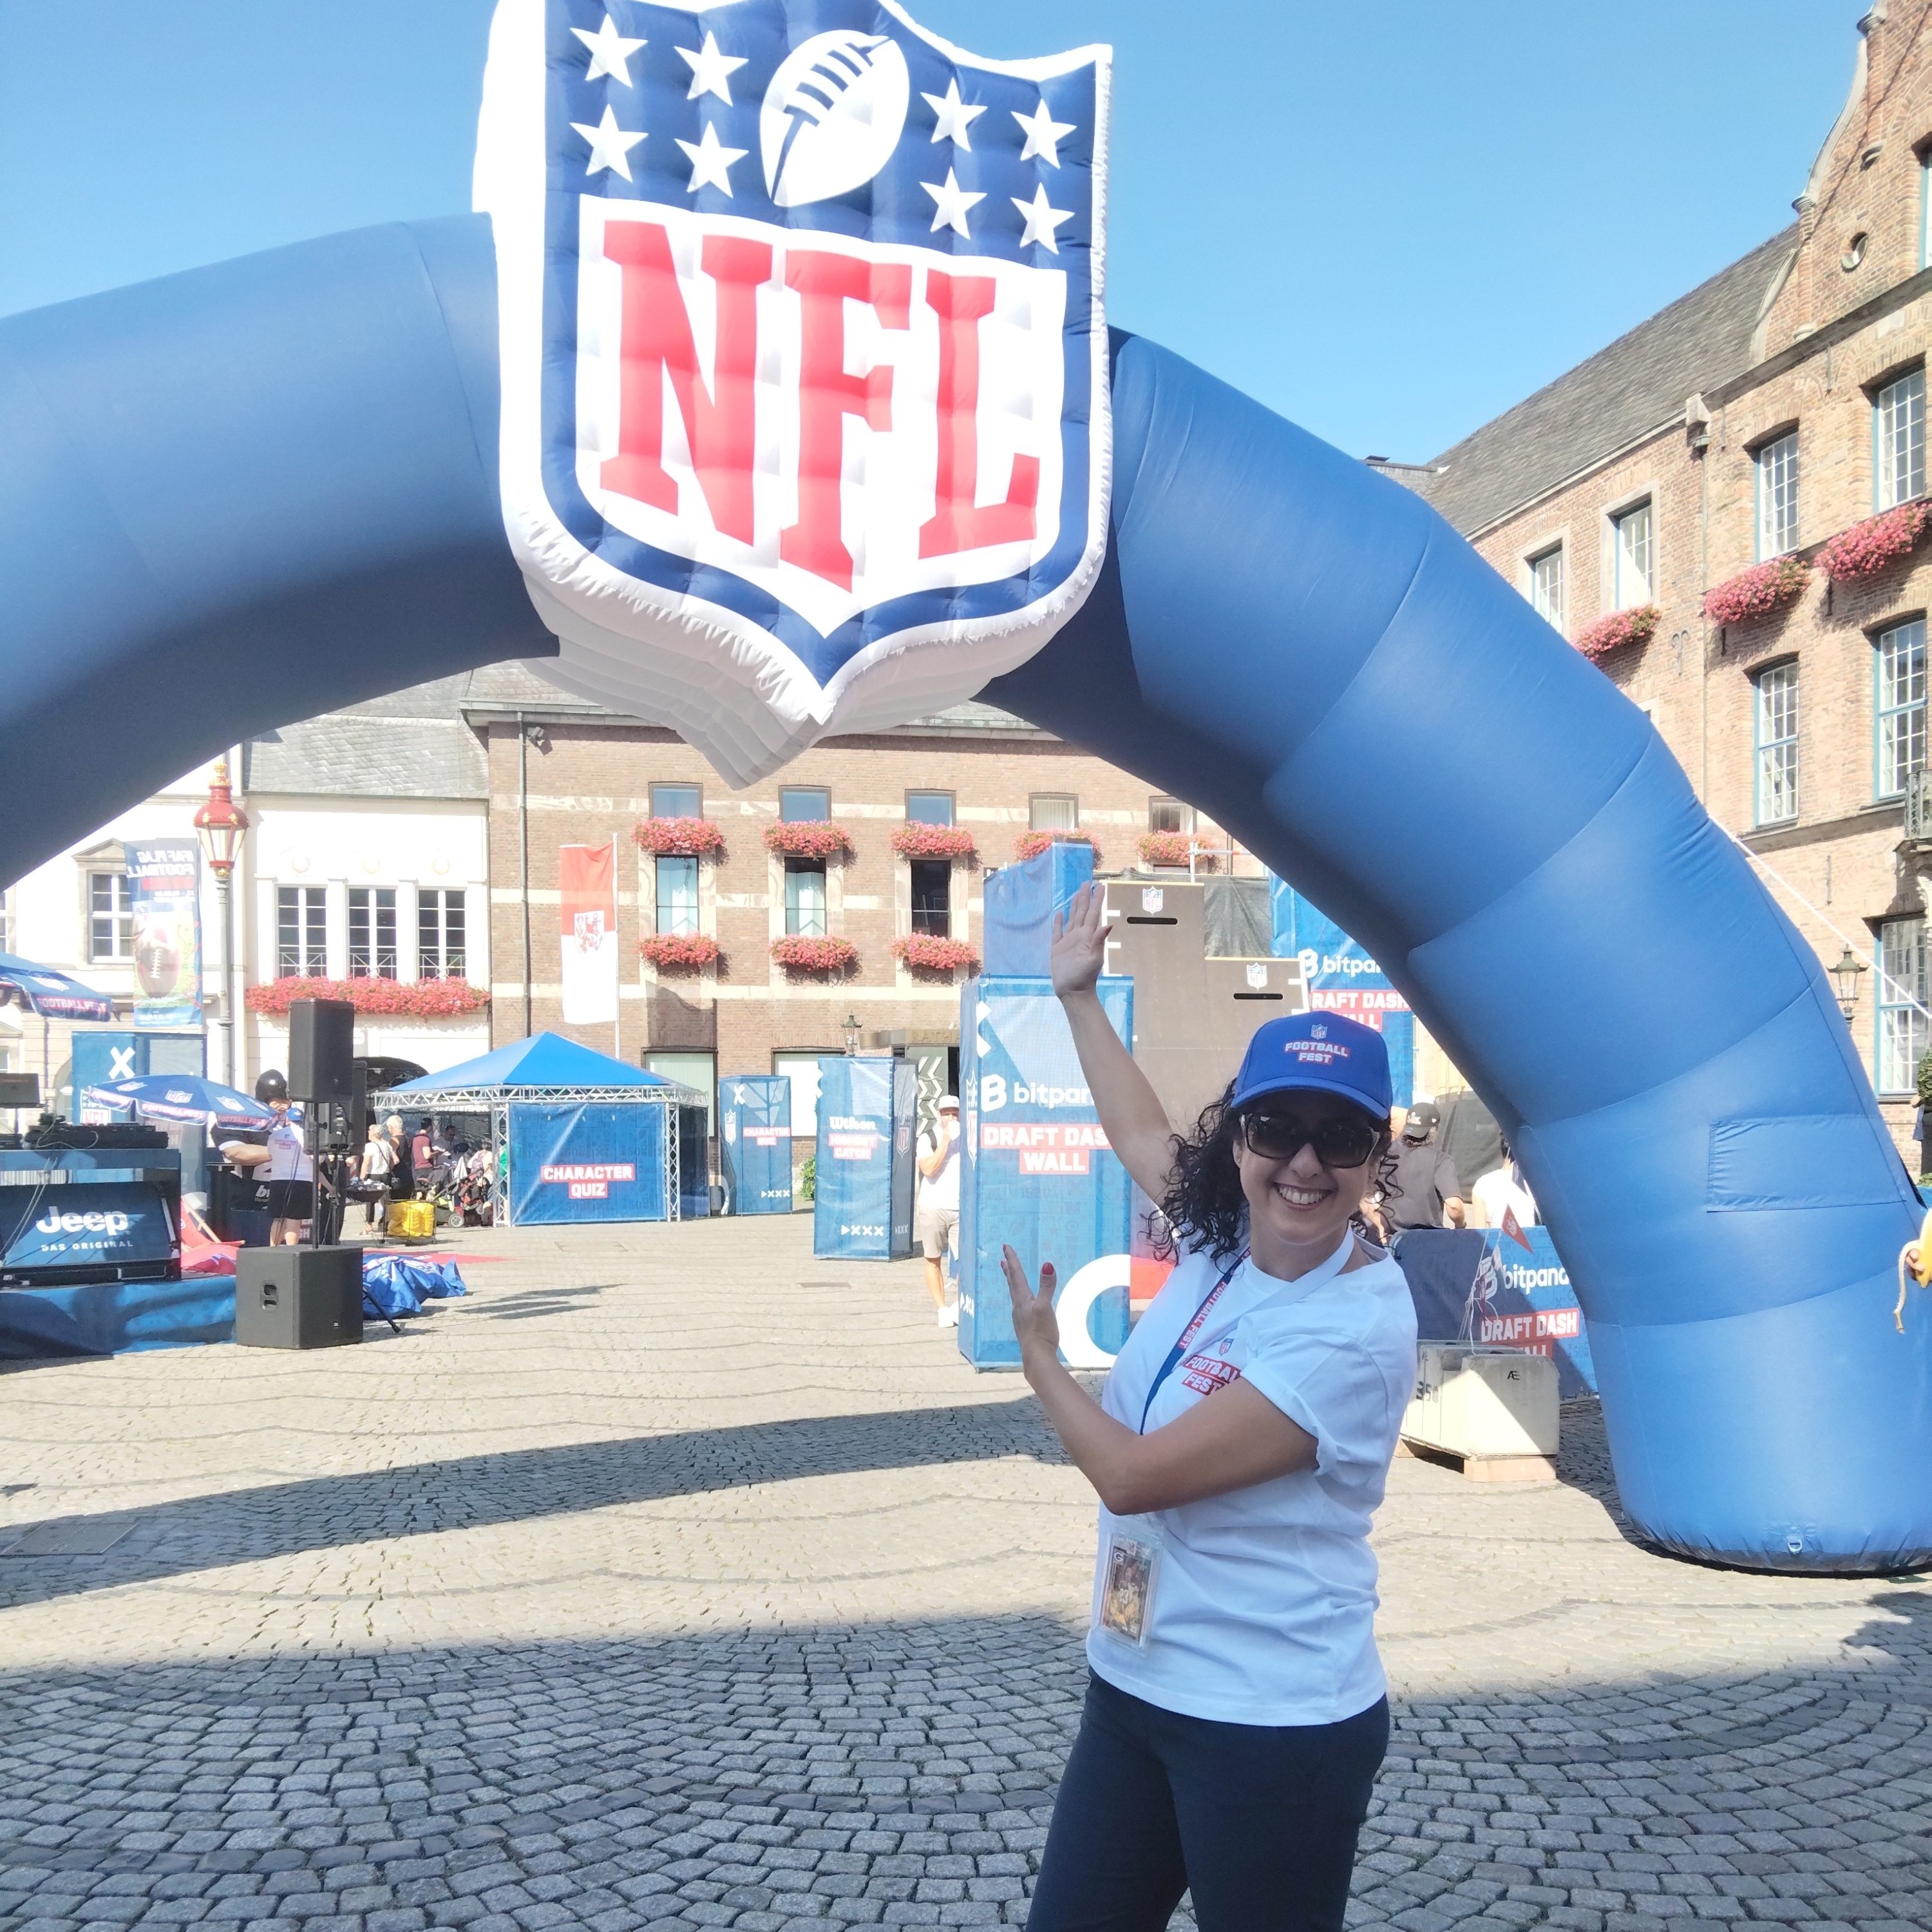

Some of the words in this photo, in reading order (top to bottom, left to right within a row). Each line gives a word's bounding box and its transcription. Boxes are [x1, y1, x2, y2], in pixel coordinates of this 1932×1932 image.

[600, 220, 1040, 594] NFL
[1323, 954, 1381, 978] bitpa
[1311, 992, 1359, 1009] RAFT
[1285, 1041, 1348, 1057] FOOTBALL
[1298, 1052, 1332, 1063] FEST
[1014, 1082, 1095, 1109] bitpan
[984, 1127, 1059, 1146] DRAFT
[1065, 1127, 1108, 1146] DAS
[1023, 1152, 1086, 1171] WALL
[544, 1166, 632, 1180] CHARACTER
[571, 1183, 605, 1198] QUIZ
[35, 1206, 128, 1236] Jeep
[41, 1244, 66, 1252] DAS
[72, 1240, 133, 1250] ORIGINAL
[1503, 1264, 1569, 1294] bitpan
[1194, 1281, 1228, 1324] FOOTBALL
[1179, 1324, 1199, 1349] FEST
[1481, 1316, 1532, 1342] DRAFT
[1536, 1312, 1578, 1336] DASH
[1186, 1356, 1240, 1382] FOOTBAL
[1184, 1372, 1222, 1393] FEST
